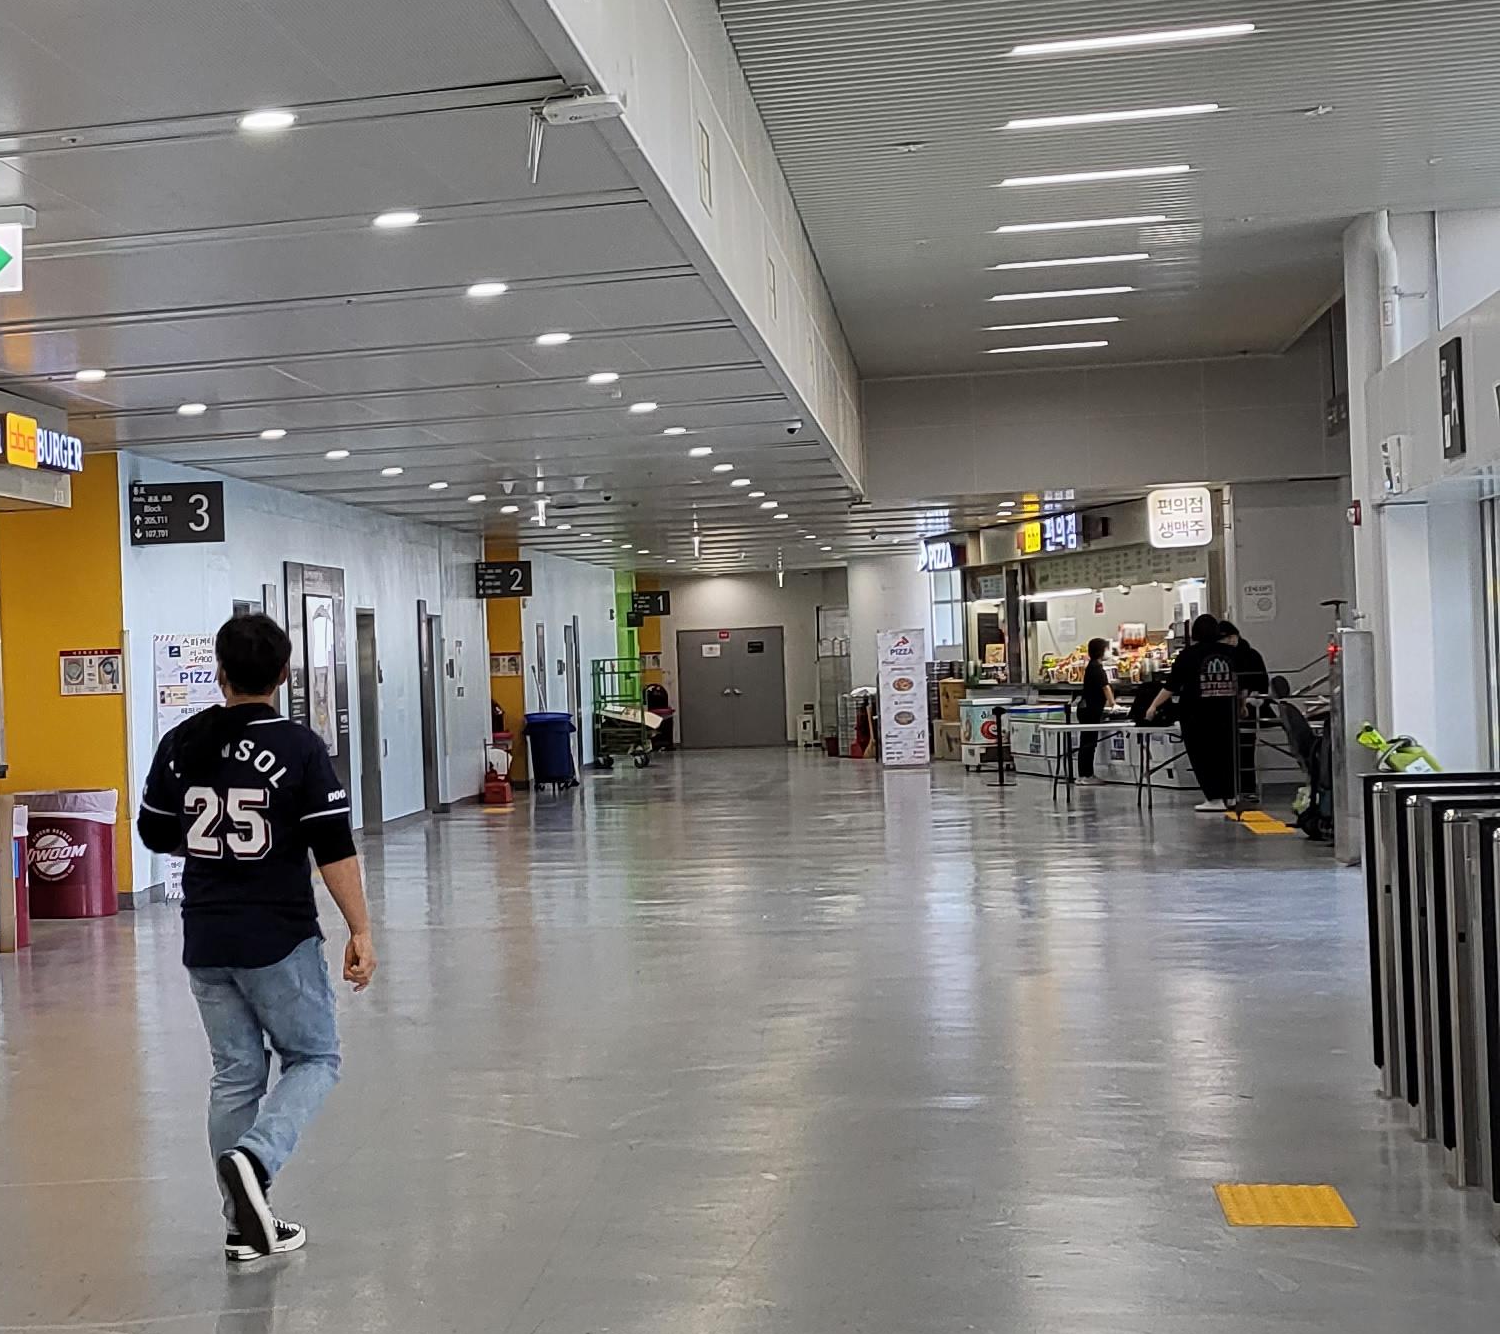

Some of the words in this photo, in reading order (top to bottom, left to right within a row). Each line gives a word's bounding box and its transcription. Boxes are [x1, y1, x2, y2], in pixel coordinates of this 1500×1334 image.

[37, 428, 83, 472] BURGER
[188, 493, 210, 532] 3
[1157, 496, 1204, 516] 편의점
[1158, 519, 1206, 538] 생맥주
[927, 541, 953, 569] PIZZA
[509, 568, 524, 591] 2
[657, 595, 664, 612] 1
[184, 786, 272, 860] 25
